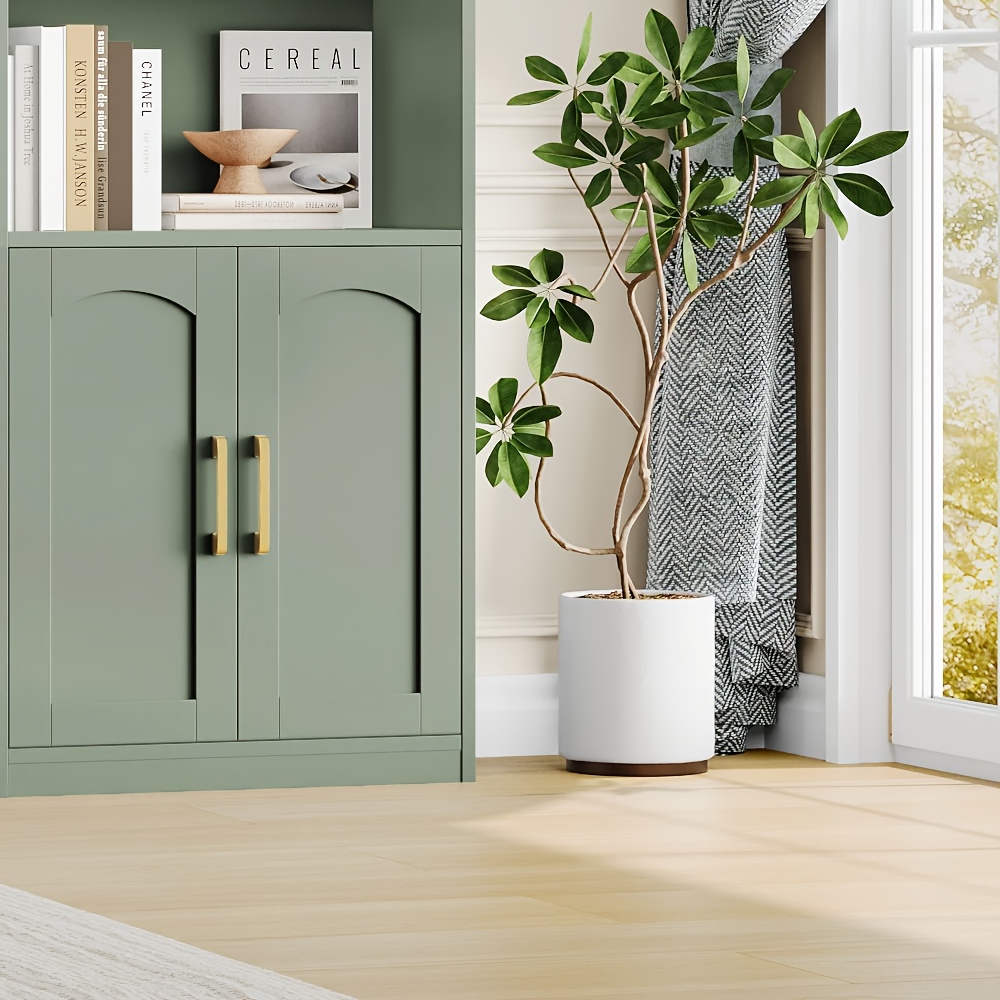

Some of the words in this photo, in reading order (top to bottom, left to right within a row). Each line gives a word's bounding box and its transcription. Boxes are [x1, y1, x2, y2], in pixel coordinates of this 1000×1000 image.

[97, 30, 107, 55] saum
[23, 63, 34, 74] At
[97, 57, 108, 72] für
[239, 47, 361, 70] CEREAL
[23, 76, 34, 101] Home
[74, 59, 87, 119] KONSTEN
[97, 73, 108, 90] alla
[141, 61, 153, 117] CHANEL
[23, 104, 34, 113] in
[97, 92, 108, 107] die
[20, 114, 34, 144] Joshua
[97, 109, 108, 151] sünderin
[23, 146, 34, 166] Tree
[71, 128, 87, 207] H.W.JANSON
[97, 156, 108, 173] lise
[97, 175, 108, 220] Grandsun
